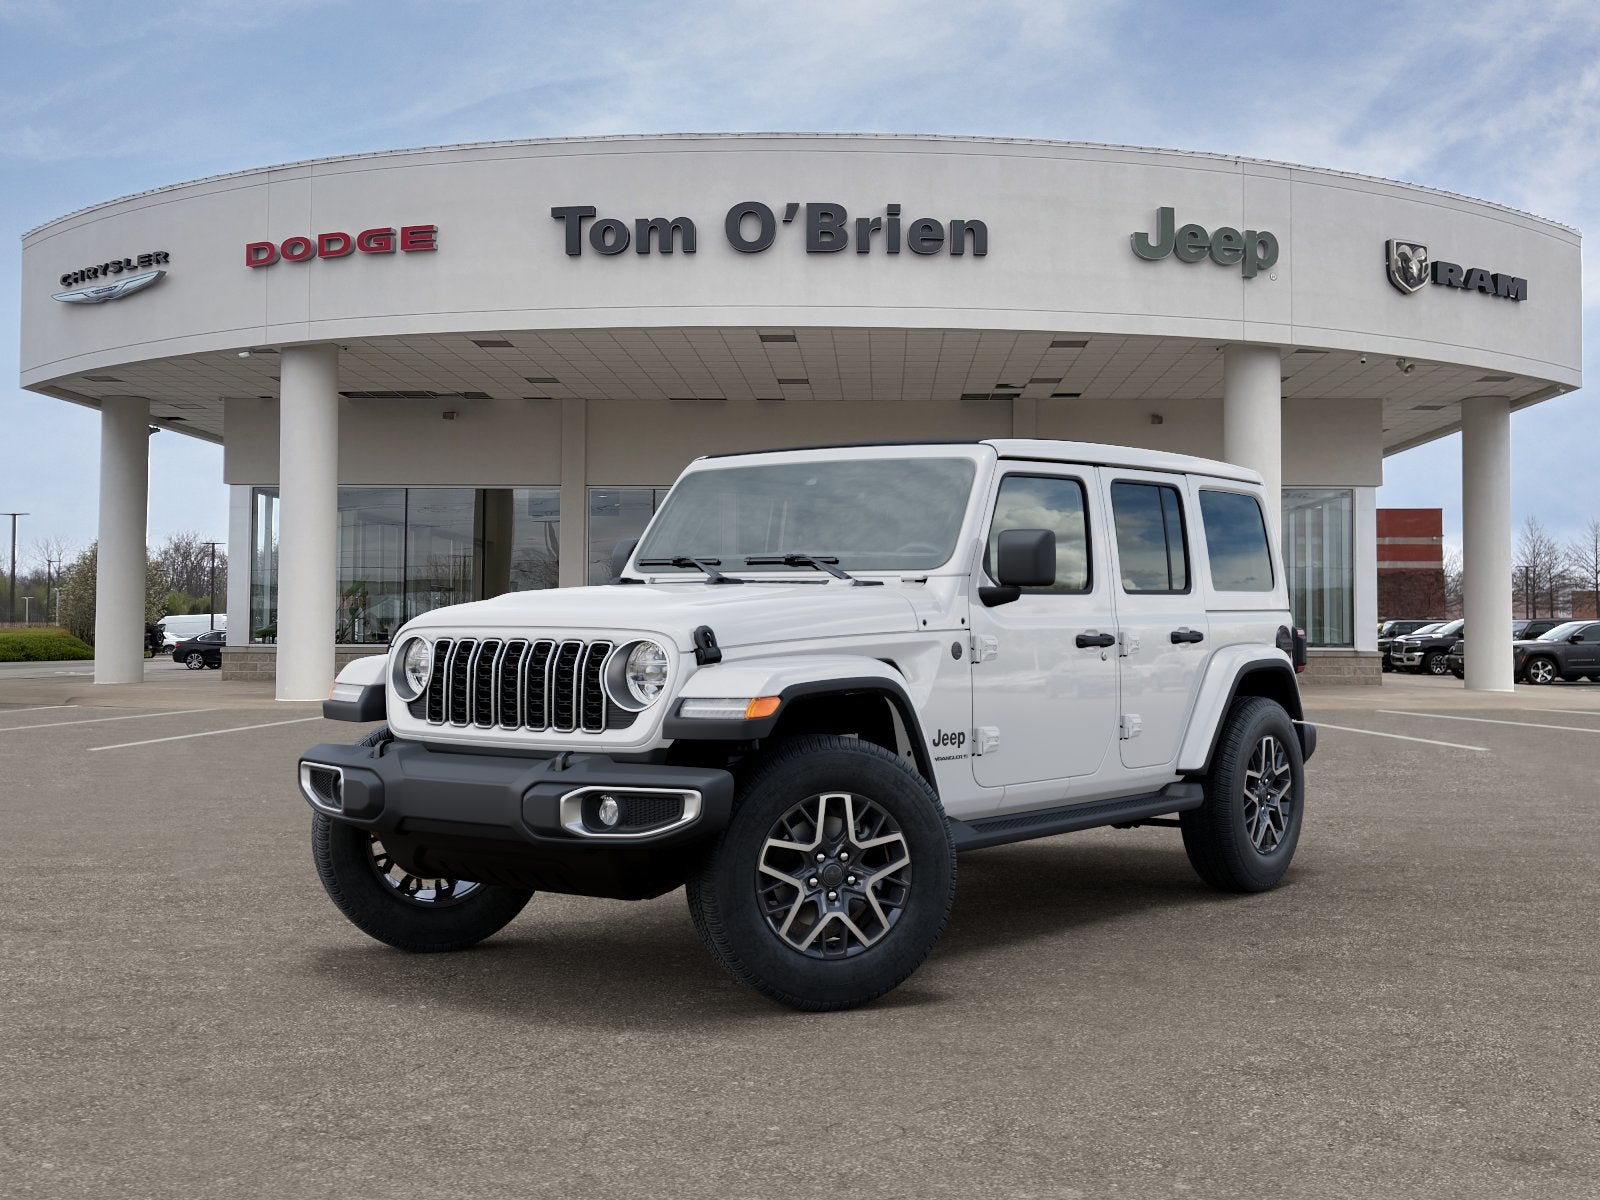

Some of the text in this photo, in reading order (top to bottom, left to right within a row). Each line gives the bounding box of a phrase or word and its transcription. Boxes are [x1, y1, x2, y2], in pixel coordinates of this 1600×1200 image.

[245, 224, 438, 269] DODGE
[550, 201, 989, 256] Tom O'Brien
[1130, 207, 1280, 278] Jeep
[60, 250, 170, 287] CHRYSLER
[1430, 260, 1528, 302] RAM
[932, 729, 966, 749] Jeep
